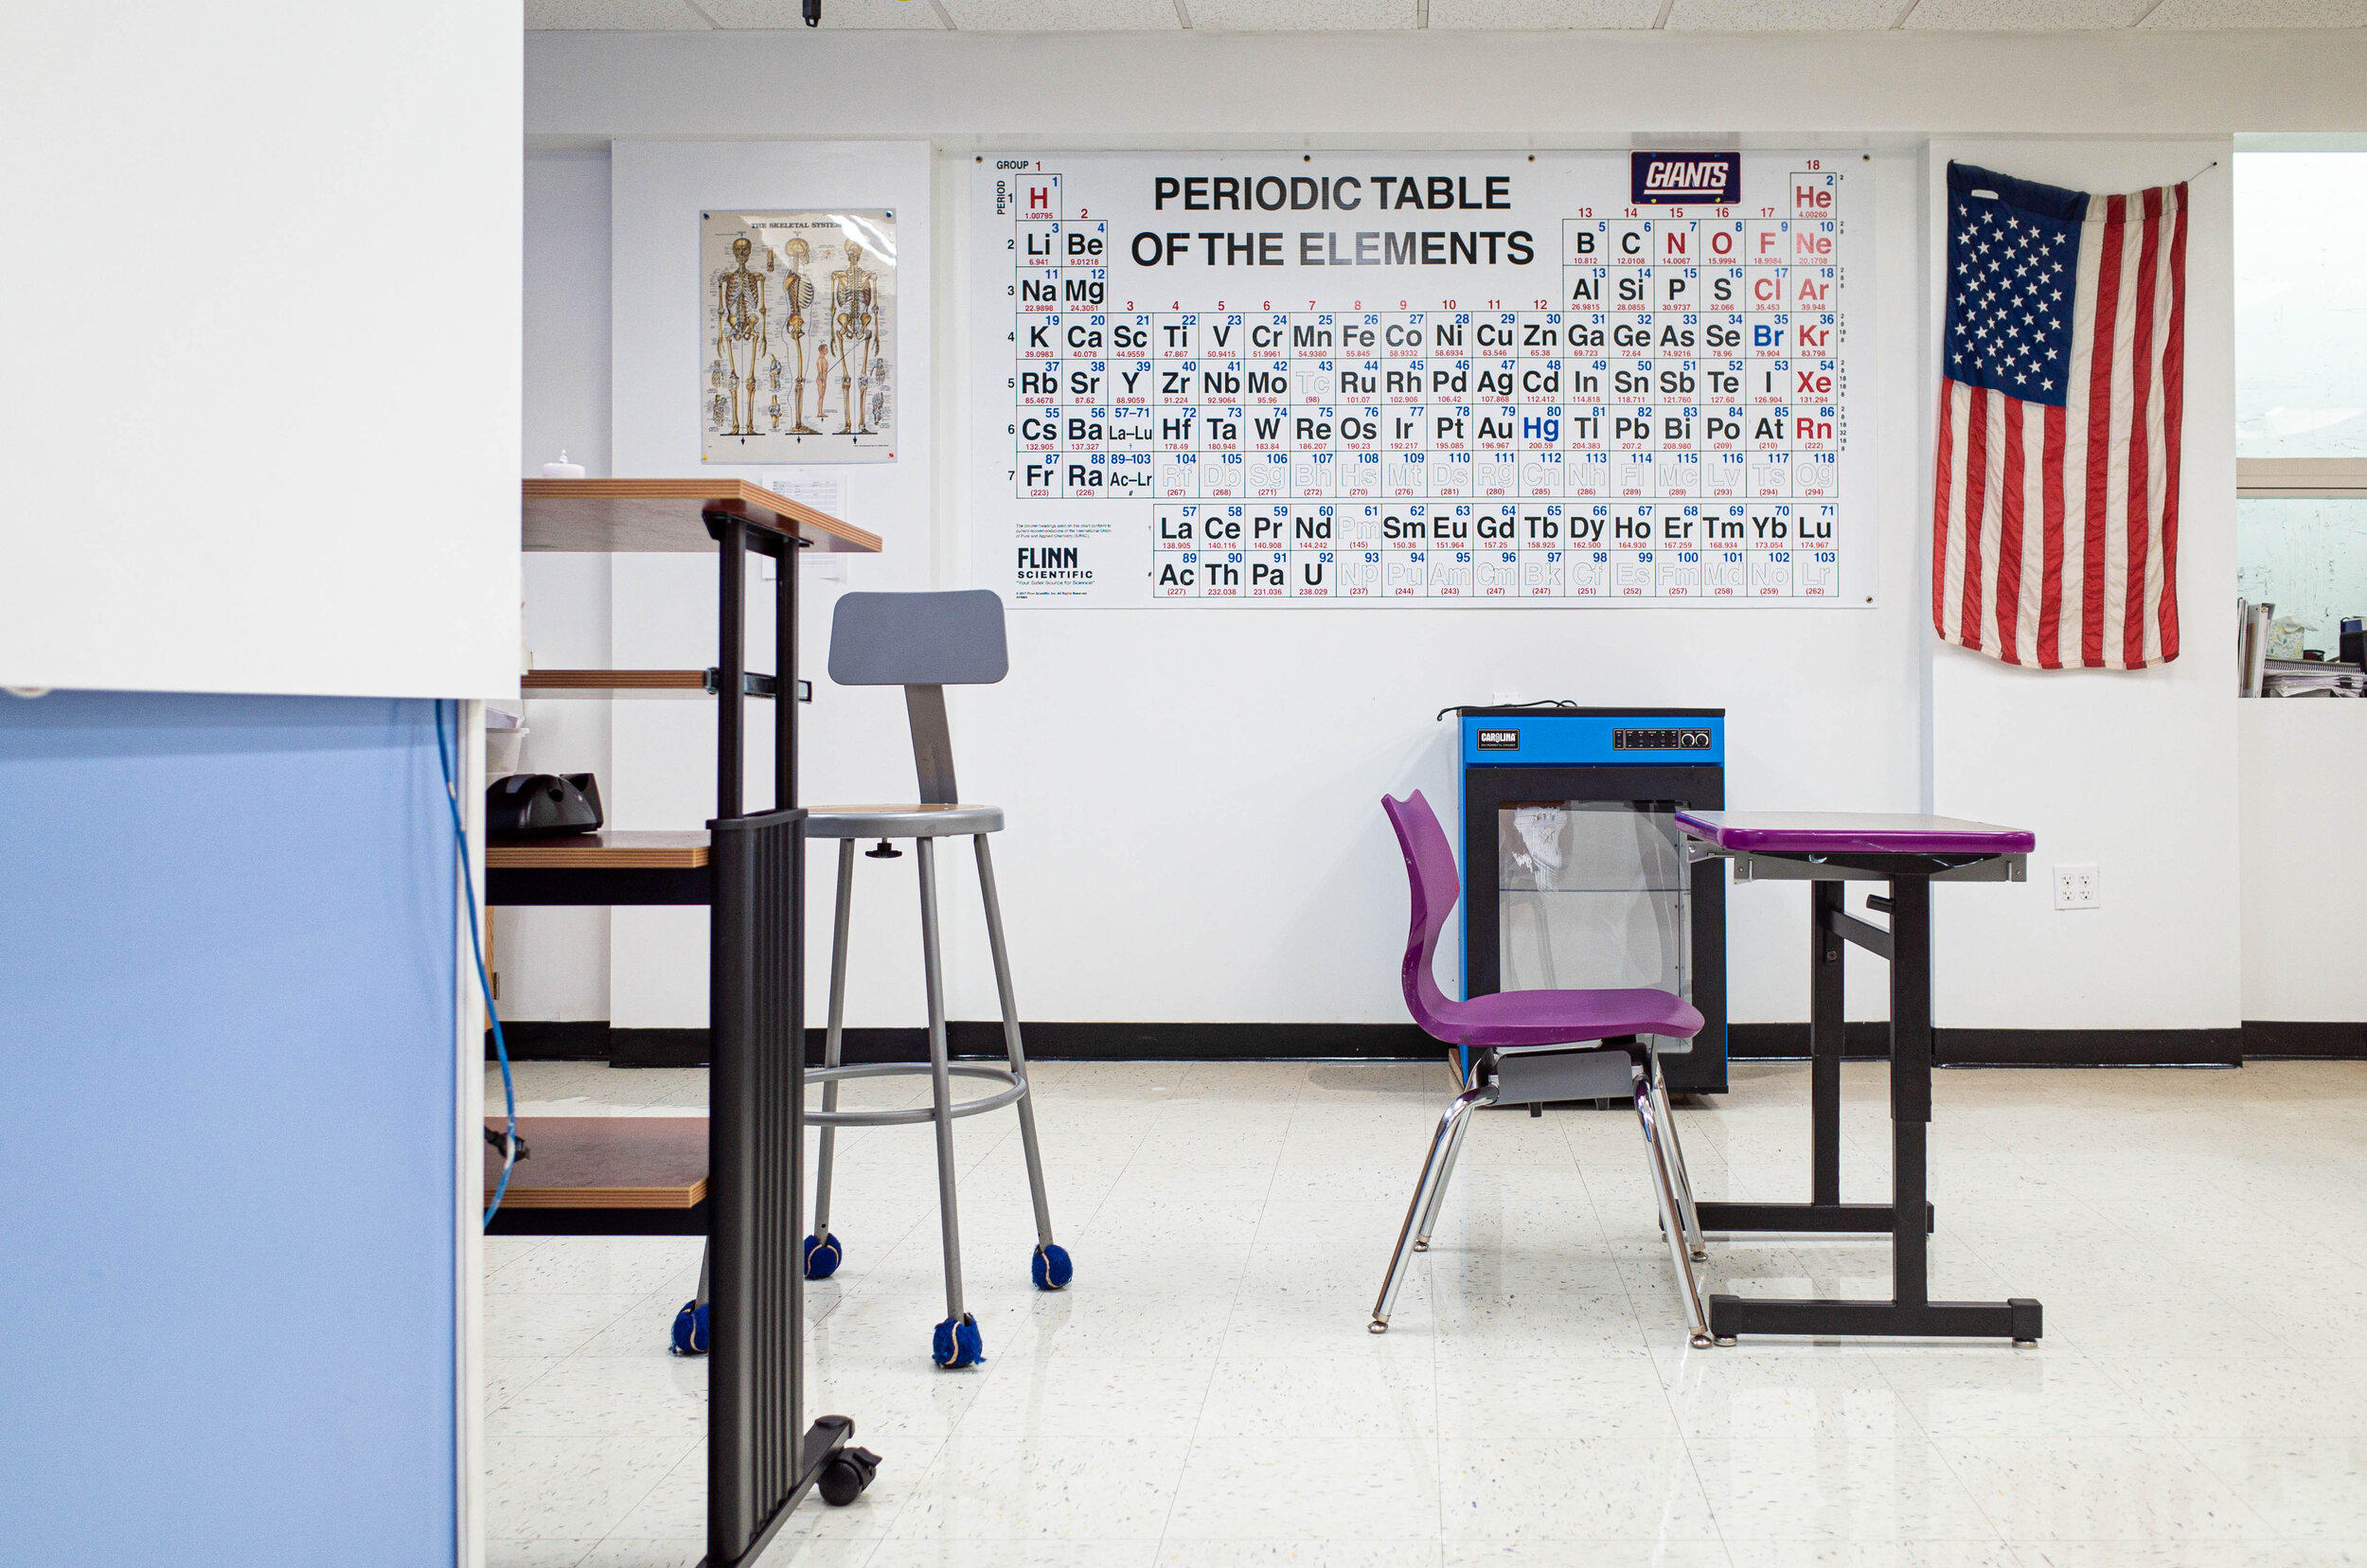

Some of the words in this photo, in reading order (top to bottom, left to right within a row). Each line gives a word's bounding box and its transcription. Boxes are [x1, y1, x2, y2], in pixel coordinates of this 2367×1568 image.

[997, 161, 1028, 169] GROUP
[1036, 161, 1041, 171] 1
[1646, 162, 1729, 187] GIANTS
[1806, 159, 1820, 170] 18
[1053, 177, 1058, 187] 1
[997, 181, 1006, 214] PERIOD
[1008, 193, 1012, 203] 1
[1030, 187, 1048, 210] H
[1155, 176, 1361, 211] PERIODIC
[1371, 176, 1510, 209] TABLE
[1796, 186, 1832, 208] He
[1081, 208, 1089, 219] 2
[1579, 207, 1593, 218] 13
[1625, 207, 1638, 218] 14
[1716, 207, 1729, 218] 16
[1097, 223, 1104, 233] 4
[1645, 222, 1651, 232] 6
[1028, 233, 1050, 255] Li
[1068, 233, 1103, 255] Be
[1131, 232, 1190, 266] OF
[1199, 232, 1284, 266] THE
[1300, 231, 1534, 265] ELEMENTS
[1577, 232, 1594, 254] B
[1622, 232, 1641, 254] C
[1667, 232, 1685, 255] N
[1712, 232, 1733, 255] O
[1760, 232, 1776, 255] F
[1796, 232, 1832, 255] Ne
[1045, 269, 1058, 279] 11
[1684, 268, 1697, 277] 15
[1023, 279, 1057, 301] Na
[1066, 279, 1104, 304] Mg
[1573, 278, 1598, 299] Al
[1619, 278, 1643, 300] Si
[1669, 278, 1685, 300] P
[1715, 278, 1731, 300] S
[1754, 278, 1780, 301] Cl
[1798, 278, 1829, 301] Ar
[1172, 301, 1179, 311] 4
[1308, 300, 1316, 311] 7
[1442, 299, 1456, 311] 10
[1534, 299, 1547, 310] 12
[1045, 314, 1059, 326] 19
[1182, 314, 1197, 327] 22
[1501, 314, 1515, 324] 29
[1774, 314, 1789, 325] 35
[1031, 325, 1049, 347] K
[1068, 325, 1102, 347] Ca
[1114, 325, 1147, 347] Sc
[1164, 325, 1186, 347] Ti
[1213, 325, 1230, 347] V
[1253, 325, 1282, 347] Cr
[1294, 325, 1331, 347] Mn
[1344, 325, 1375, 347] Fe
[1386, 325, 1422, 347] Co
[1437, 325, 1462, 346] Ni
[1477, 325, 1512, 346] Cu
[1524, 325, 1557, 346] Zn
[1569, 325, 1604, 347] Ga
[1614, 325, 1650, 347] Ge
[1660, 325, 1694, 347] As
[1706, 325, 1740, 347] Se
[1754, 325, 1785, 347] Br
[1799, 325, 1829, 347] Kr
[1272, 361, 1288, 371] 42
[1023, 371, 1058, 394] Rb
[1071, 371, 1099, 394] Sr
[1122, 371, 1139, 393] Y
[1163, 371, 1190, 393] Zr
[1204, 371, 1239, 394] Nb
[1249, 371, 1287, 393] Mo
[1342, 371, 1376, 393] Ru
[1387, 370, 1421, 392] Rh
[1433, 370, 1466, 392] Pd
[1477, 370, 1512, 395] Ag
[1523, 370, 1558, 392] Cd
[1575, 370, 1597, 392] In
[1615, 370, 1648, 393] Sn
[1661, 370, 1695, 393] Sb
[1708, 371, 1738, 393] Te
[1766, 370, 1771, 393] I
[1796, 370, 1831, 394] Xe
[1638, 407, 1652, 417] 82
[1023, 418, 1057, 440] Cs
[1069, 418, 1102, 440] Ba
[1164, 418, 1191, 439] Hf
[1207, 418, 1237, 439] Ta
[1255, 418, 1280, 439] W
[1297, 418, 1331, 439] Re
[1341, 417, 1377, 439] Os
[1397, 417, 1413, 438] Ir
[1438, 417, 1464, 438] Pt
[1478, 417, 1512, 438] Au
[1524, 418, 1558, 442] Hg
[1575, 417, 1597, 438] Tl
[1616, 417, 1649, 439] Pb
[1665, 417, 1690, 438] Bi
[1708, 417, 1739, 439] Po
[1755, 417, 1783, 438] At
[1796, 417, 1832, 439] Rn
[1091, 454, 1105, 464] 88
[1027, 464, 1054, 486] Fr
[1069, 464, 1103, 487] Ra
[1547, 506, 1561, 516] 65
[1162, 517, 1192, 539] La
[1205, 516, 1240, 539] Ce
[1255, 517, 1282, 539] Pr
[1296, 516, 1330, 539] Nd
[1383, 516, 1425, 539] Sm
[1434, 516, 1467, 538] Eu
[1477, 516, 1514, 538] Gd
[1524, 516, 1557, 538] Tb
[1571, 516, 1604, 542] Dy
[1616, 516, 1650, 539] Ho
[1665, 516, 1693, 538] Er
[1702, 516, 1743, 538] Tm
[1753, 516, 1787, 538] Yb
[1800, 516, 1830, 538] Lu
[1019, 547, 1077, 568] FLINN
[1160, 563, 1194, 585] Ac
[1205, 563, 1237, 585] Th
[1253, 563, 1284, 585] Pa
[1306, 562, 1322, 585] U
[1481, 733, 1516, 742] CAROLINA
